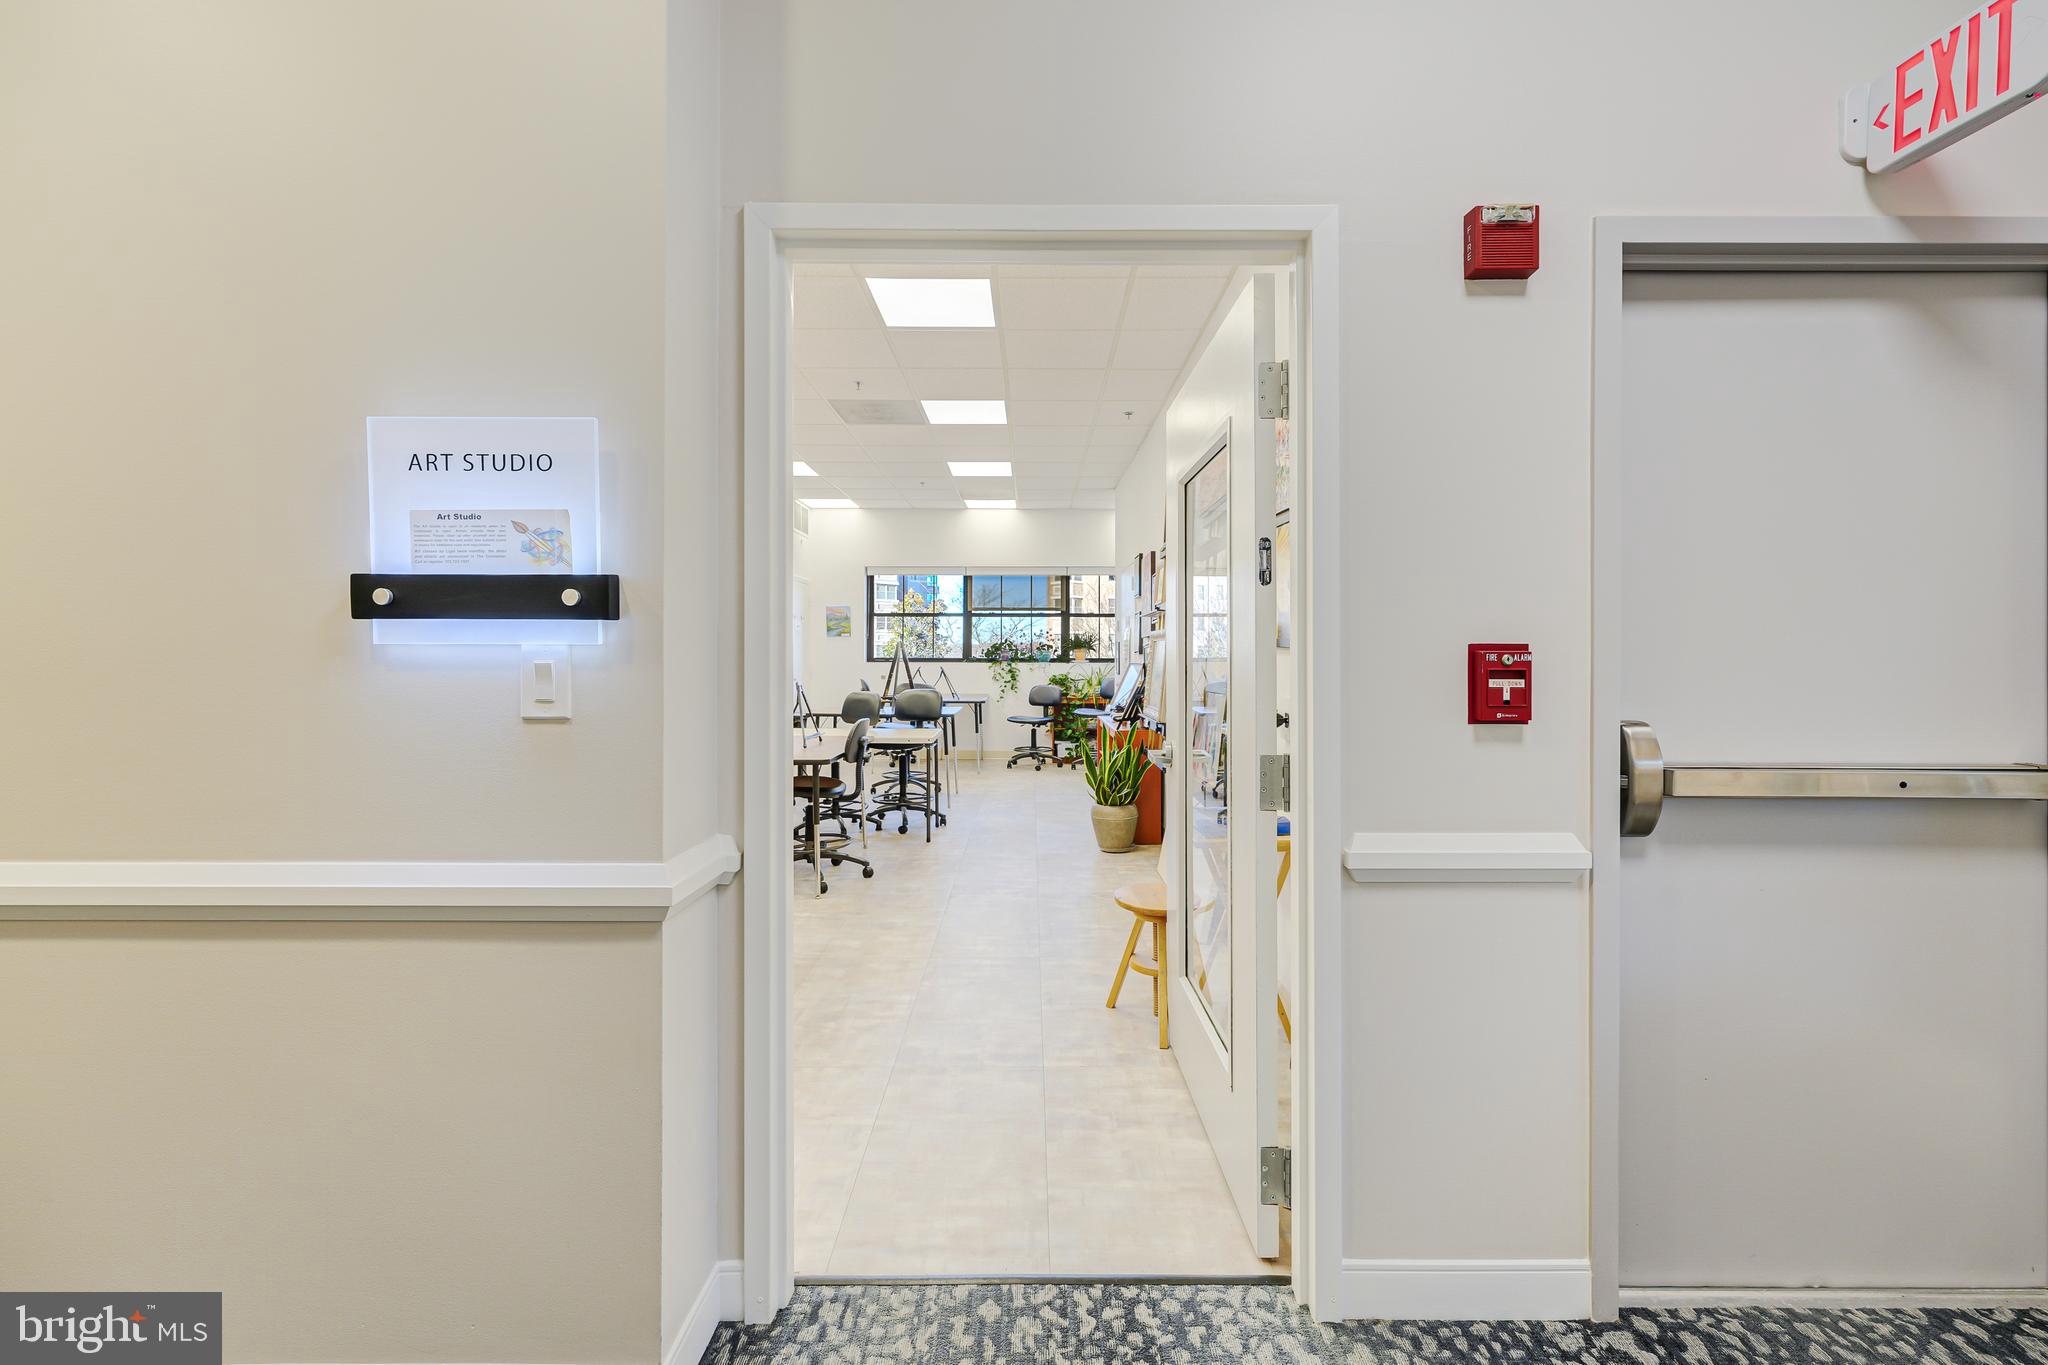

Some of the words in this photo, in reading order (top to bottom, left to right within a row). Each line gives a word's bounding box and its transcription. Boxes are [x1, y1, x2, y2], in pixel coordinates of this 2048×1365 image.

[1893, 0, 2018, 153] EXIT
[408, 453, 453, 472] ART
[463, 453, 553, 472] STUDIO
